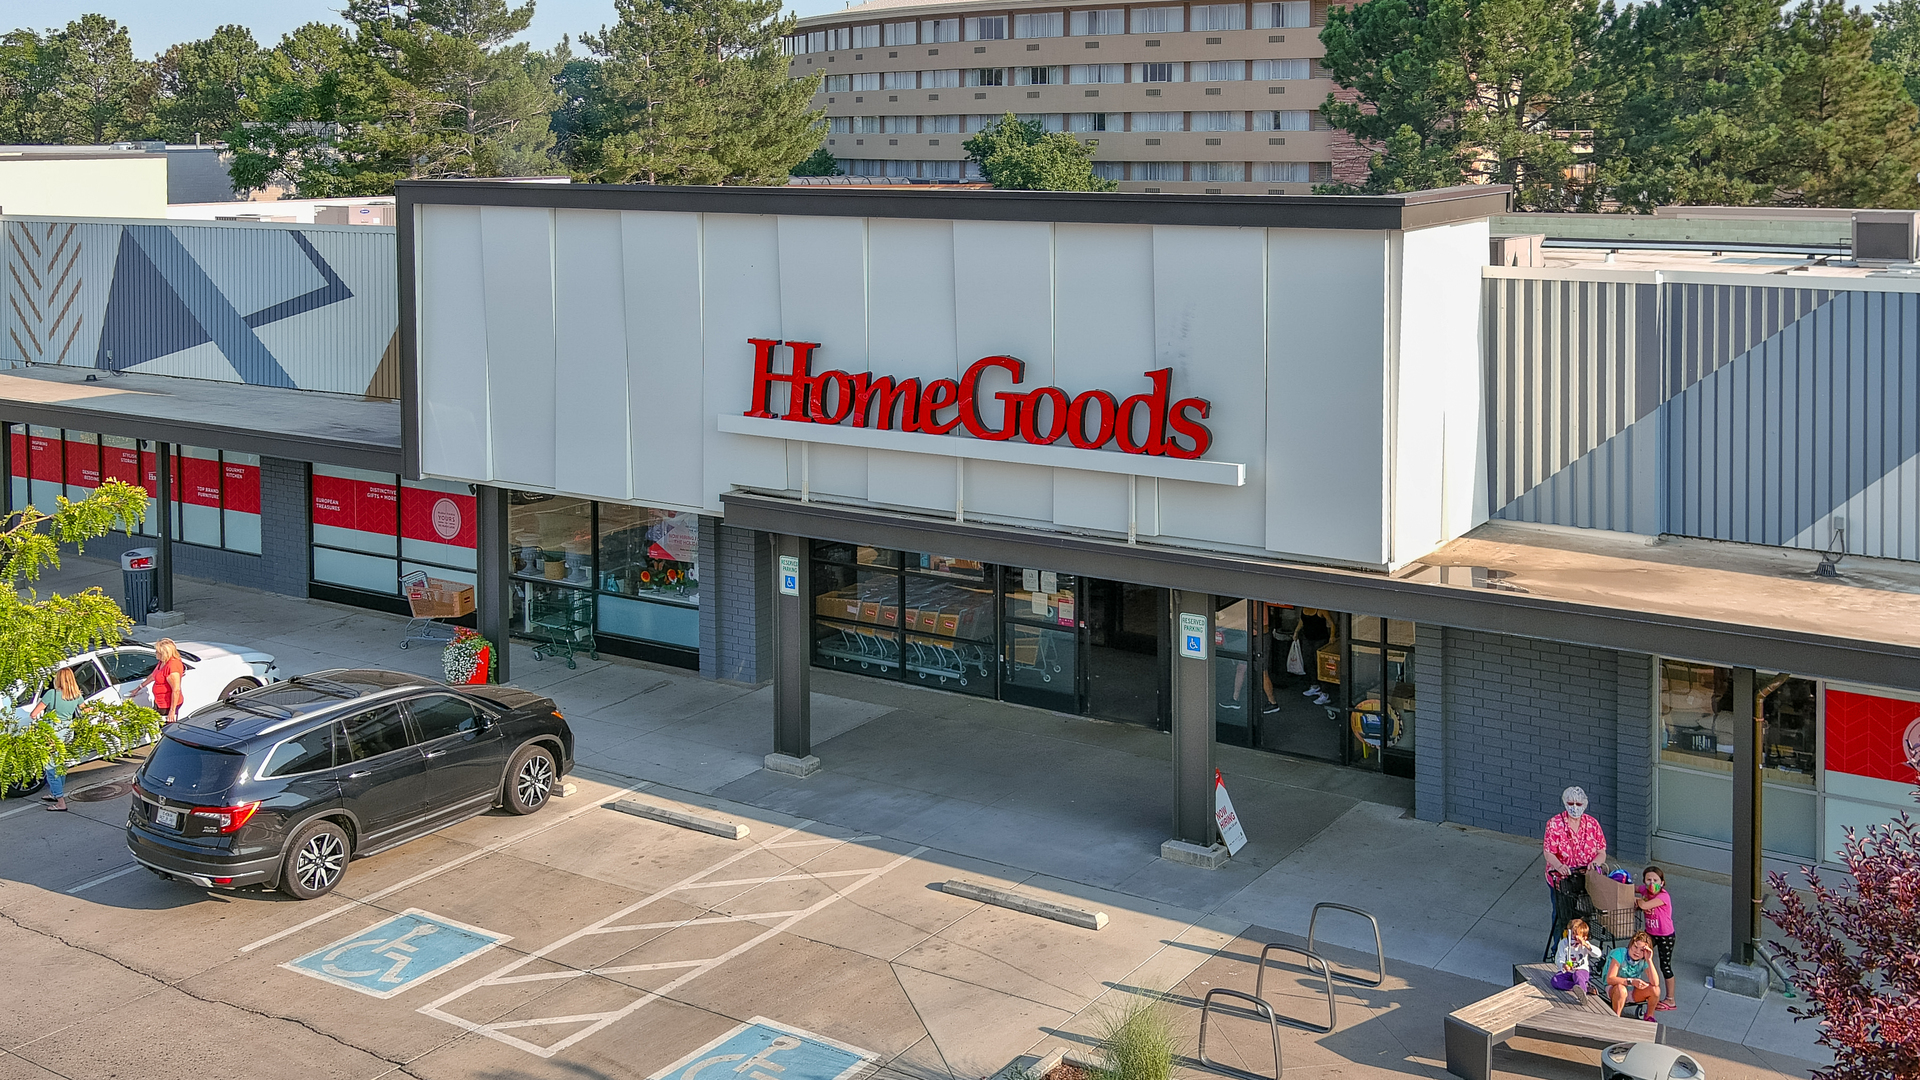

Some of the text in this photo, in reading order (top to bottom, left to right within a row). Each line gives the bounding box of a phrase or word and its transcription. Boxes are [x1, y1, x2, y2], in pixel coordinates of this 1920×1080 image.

[744, 337, 1213, 459] HomeGoods
[226, 466, 245, 474] GOURMET
[226, 472, 243, 480] KITCHEN
[197, 491, 219, 500] FURNITURE
[369, 486, 397, 496] DISTINCTIVE
[316, 497, 339, 505] EUROPEAN
[316, 503, 341, 512] TREASURES
[438, 514, 456, 523] YOURS
[1182, 617, 1205, 626] RESERVED
[1184, 625, 1203, 633] PARKING
[1215, 805, 1228, 821] NOW
[1219, 811, 1236, 830] HIRING
